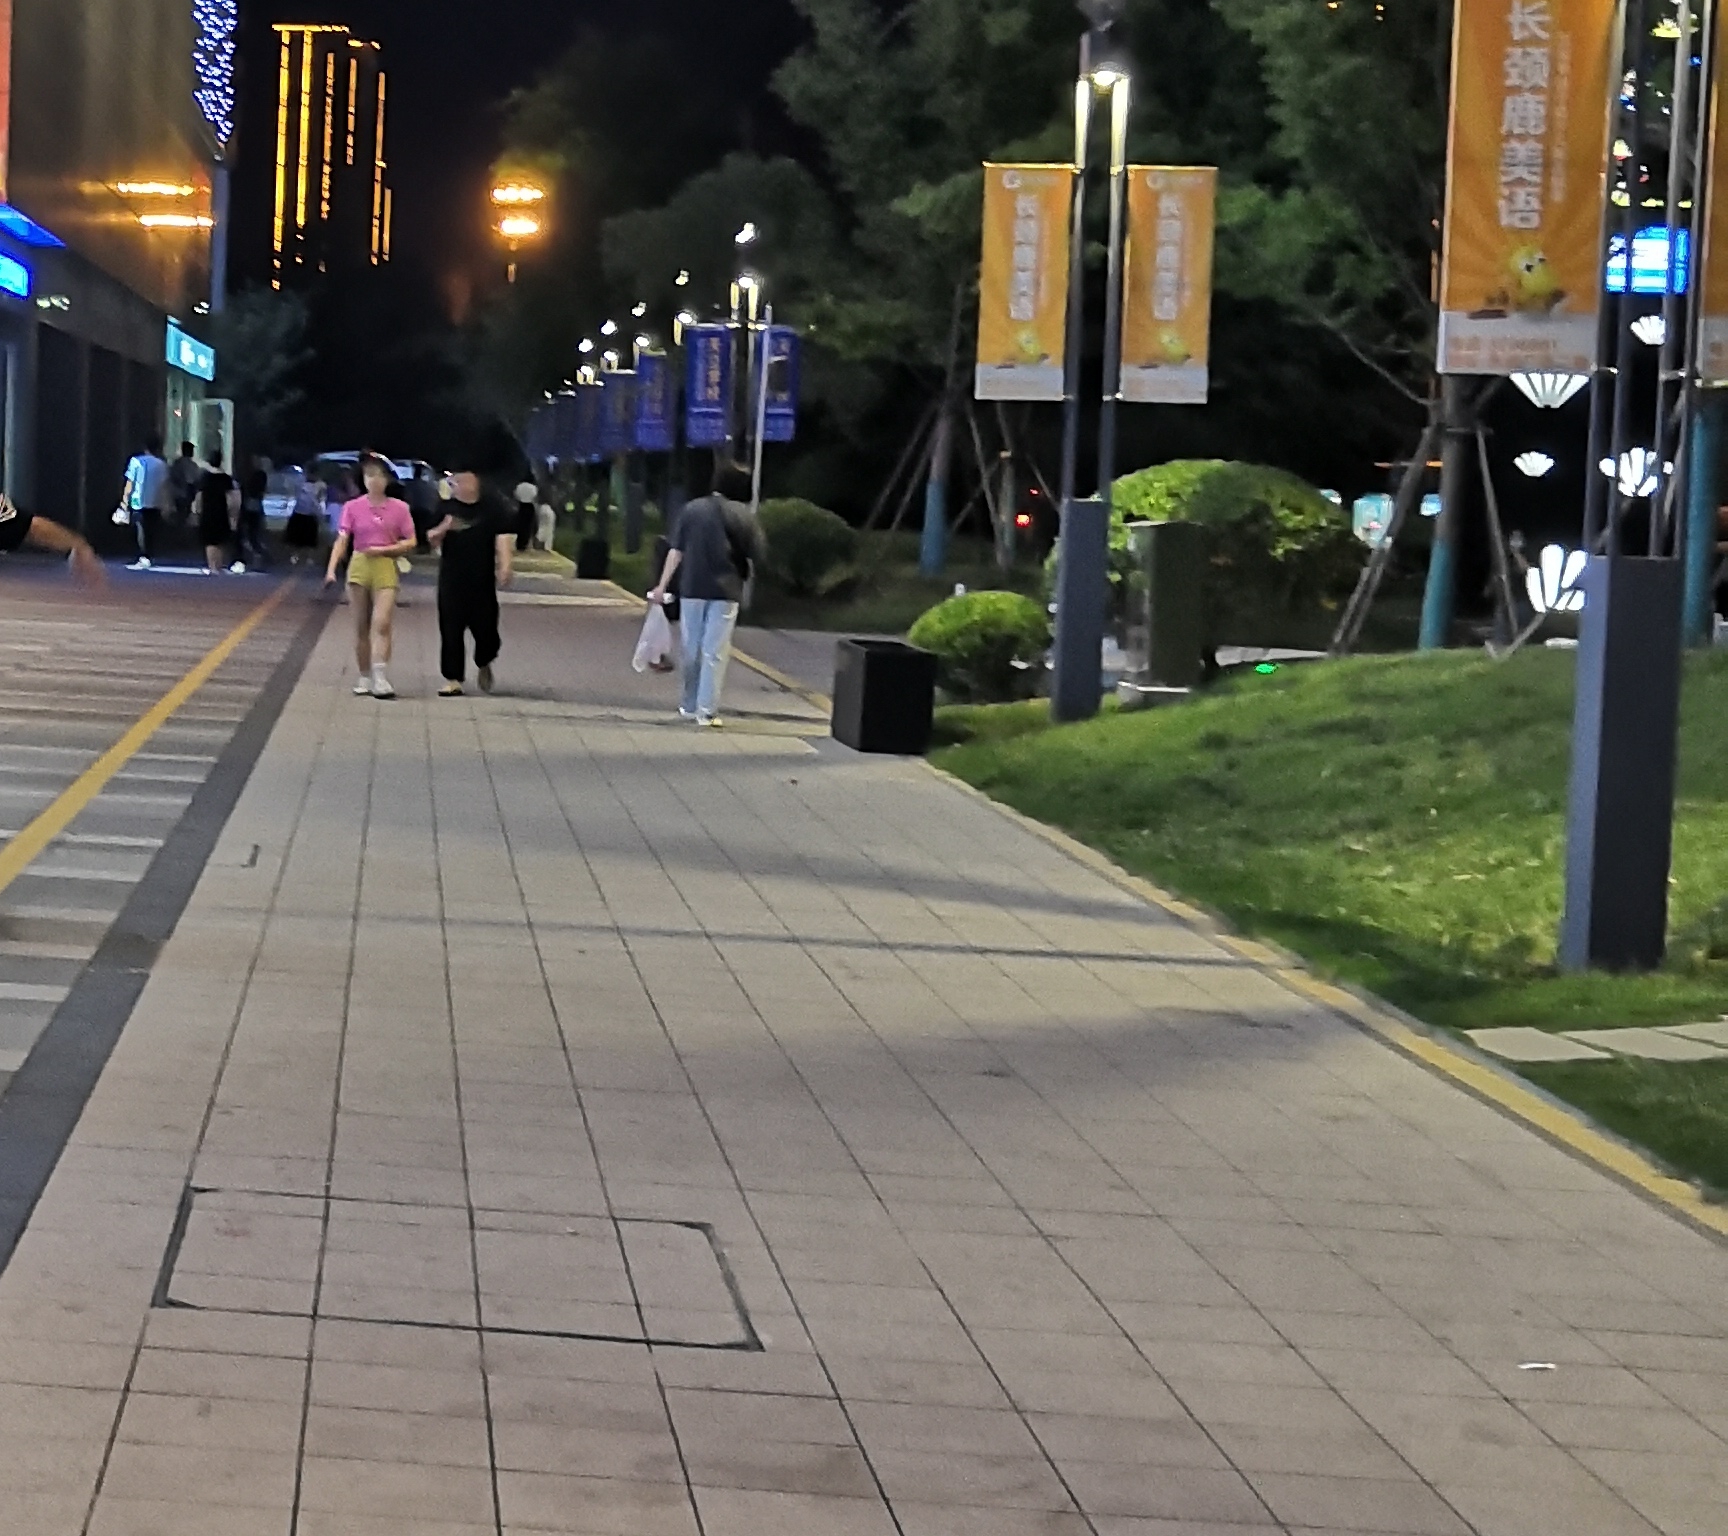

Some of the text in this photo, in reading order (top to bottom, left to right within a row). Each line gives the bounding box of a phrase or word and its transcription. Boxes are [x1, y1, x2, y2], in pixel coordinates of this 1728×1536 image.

[1498, 0, 1552, 229] 长颈鹿美语
